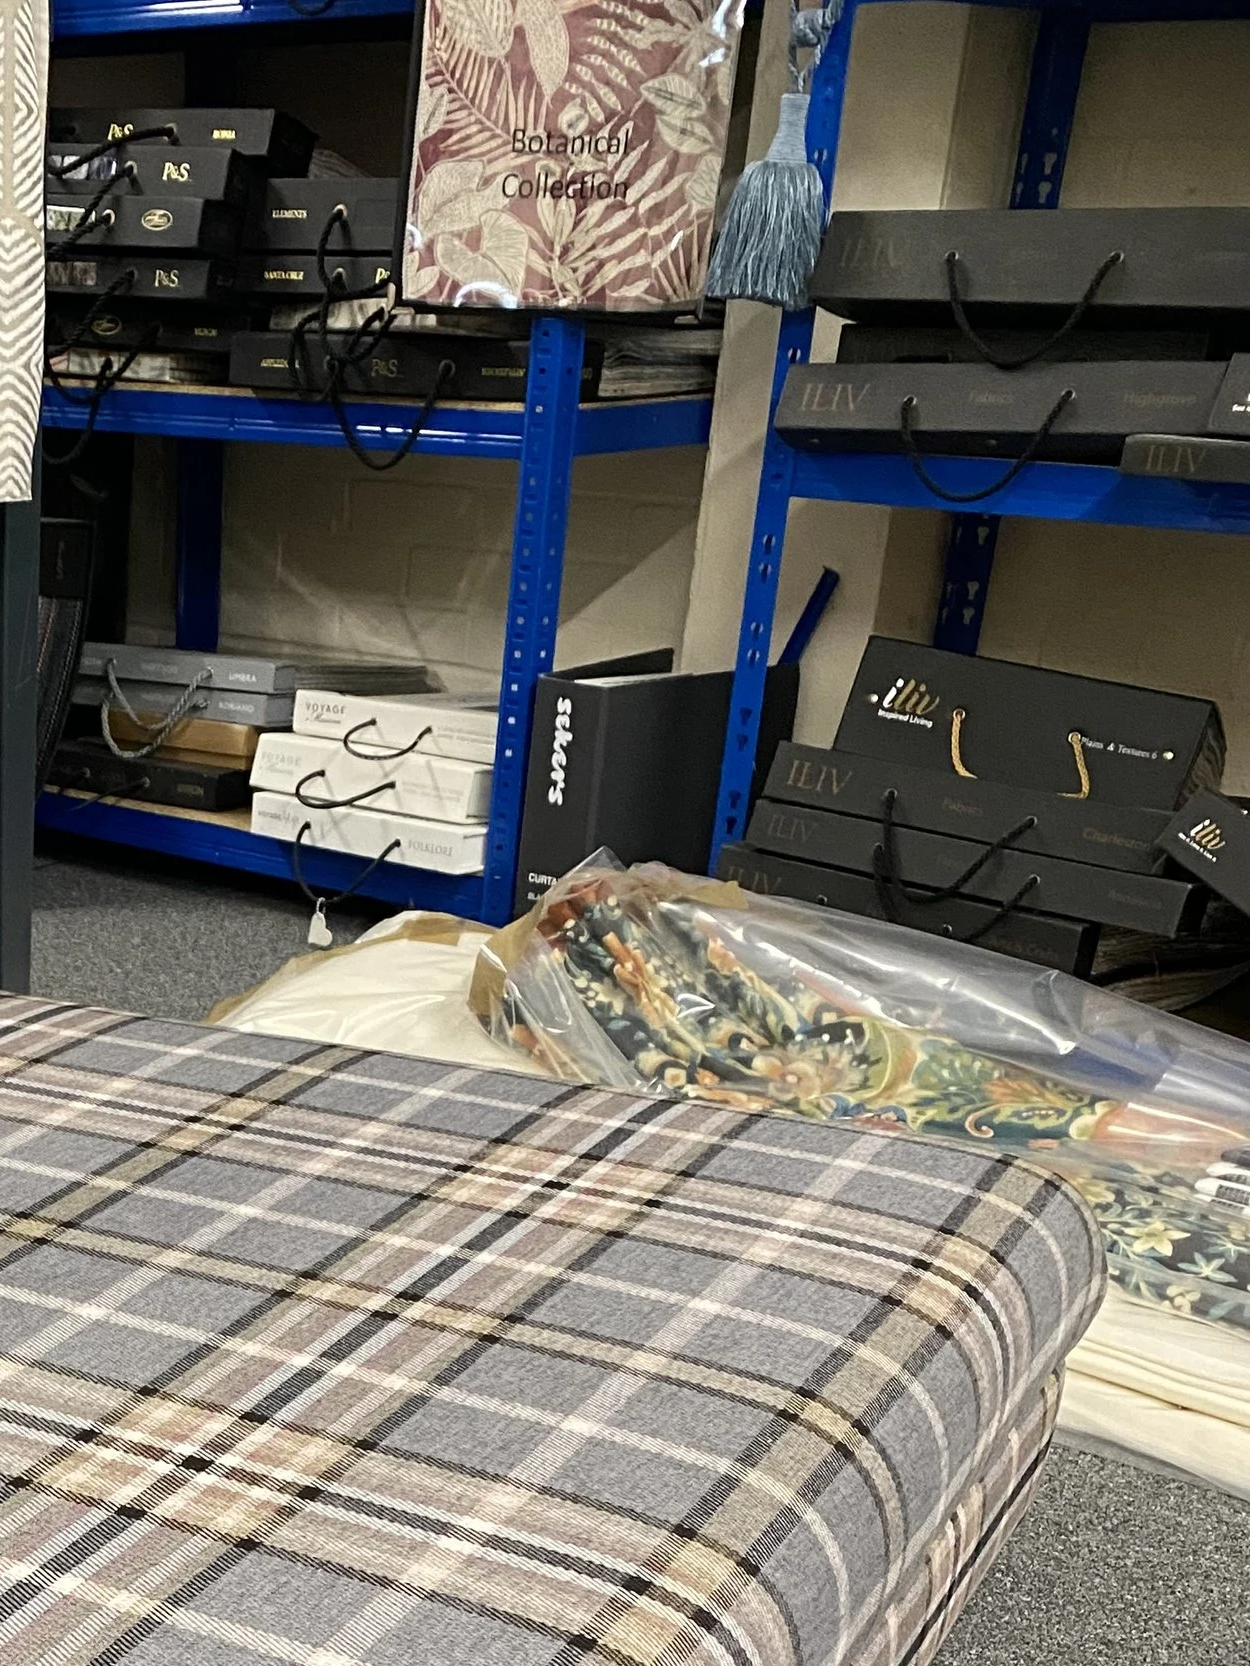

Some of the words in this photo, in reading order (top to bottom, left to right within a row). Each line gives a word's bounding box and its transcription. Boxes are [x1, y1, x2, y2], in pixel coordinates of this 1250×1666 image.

[511, 128, 630, 155] Botanical
[162, 162, 191, 182] P&S
[502, 172, 629, 199] Collection
[154, 269, 179, 288] P&S
[371, 359, 398, 378] P&S
[801, 382, 871, 412] ILIV
[1145, 444, 1207, 473] ILIV
[305, 702, 346, 715] VOYAGE
[787, 760, 854, 795] ILIV
[767, 814, 819, 843] ILIV
[528, 873, 558, 887] CURTA
